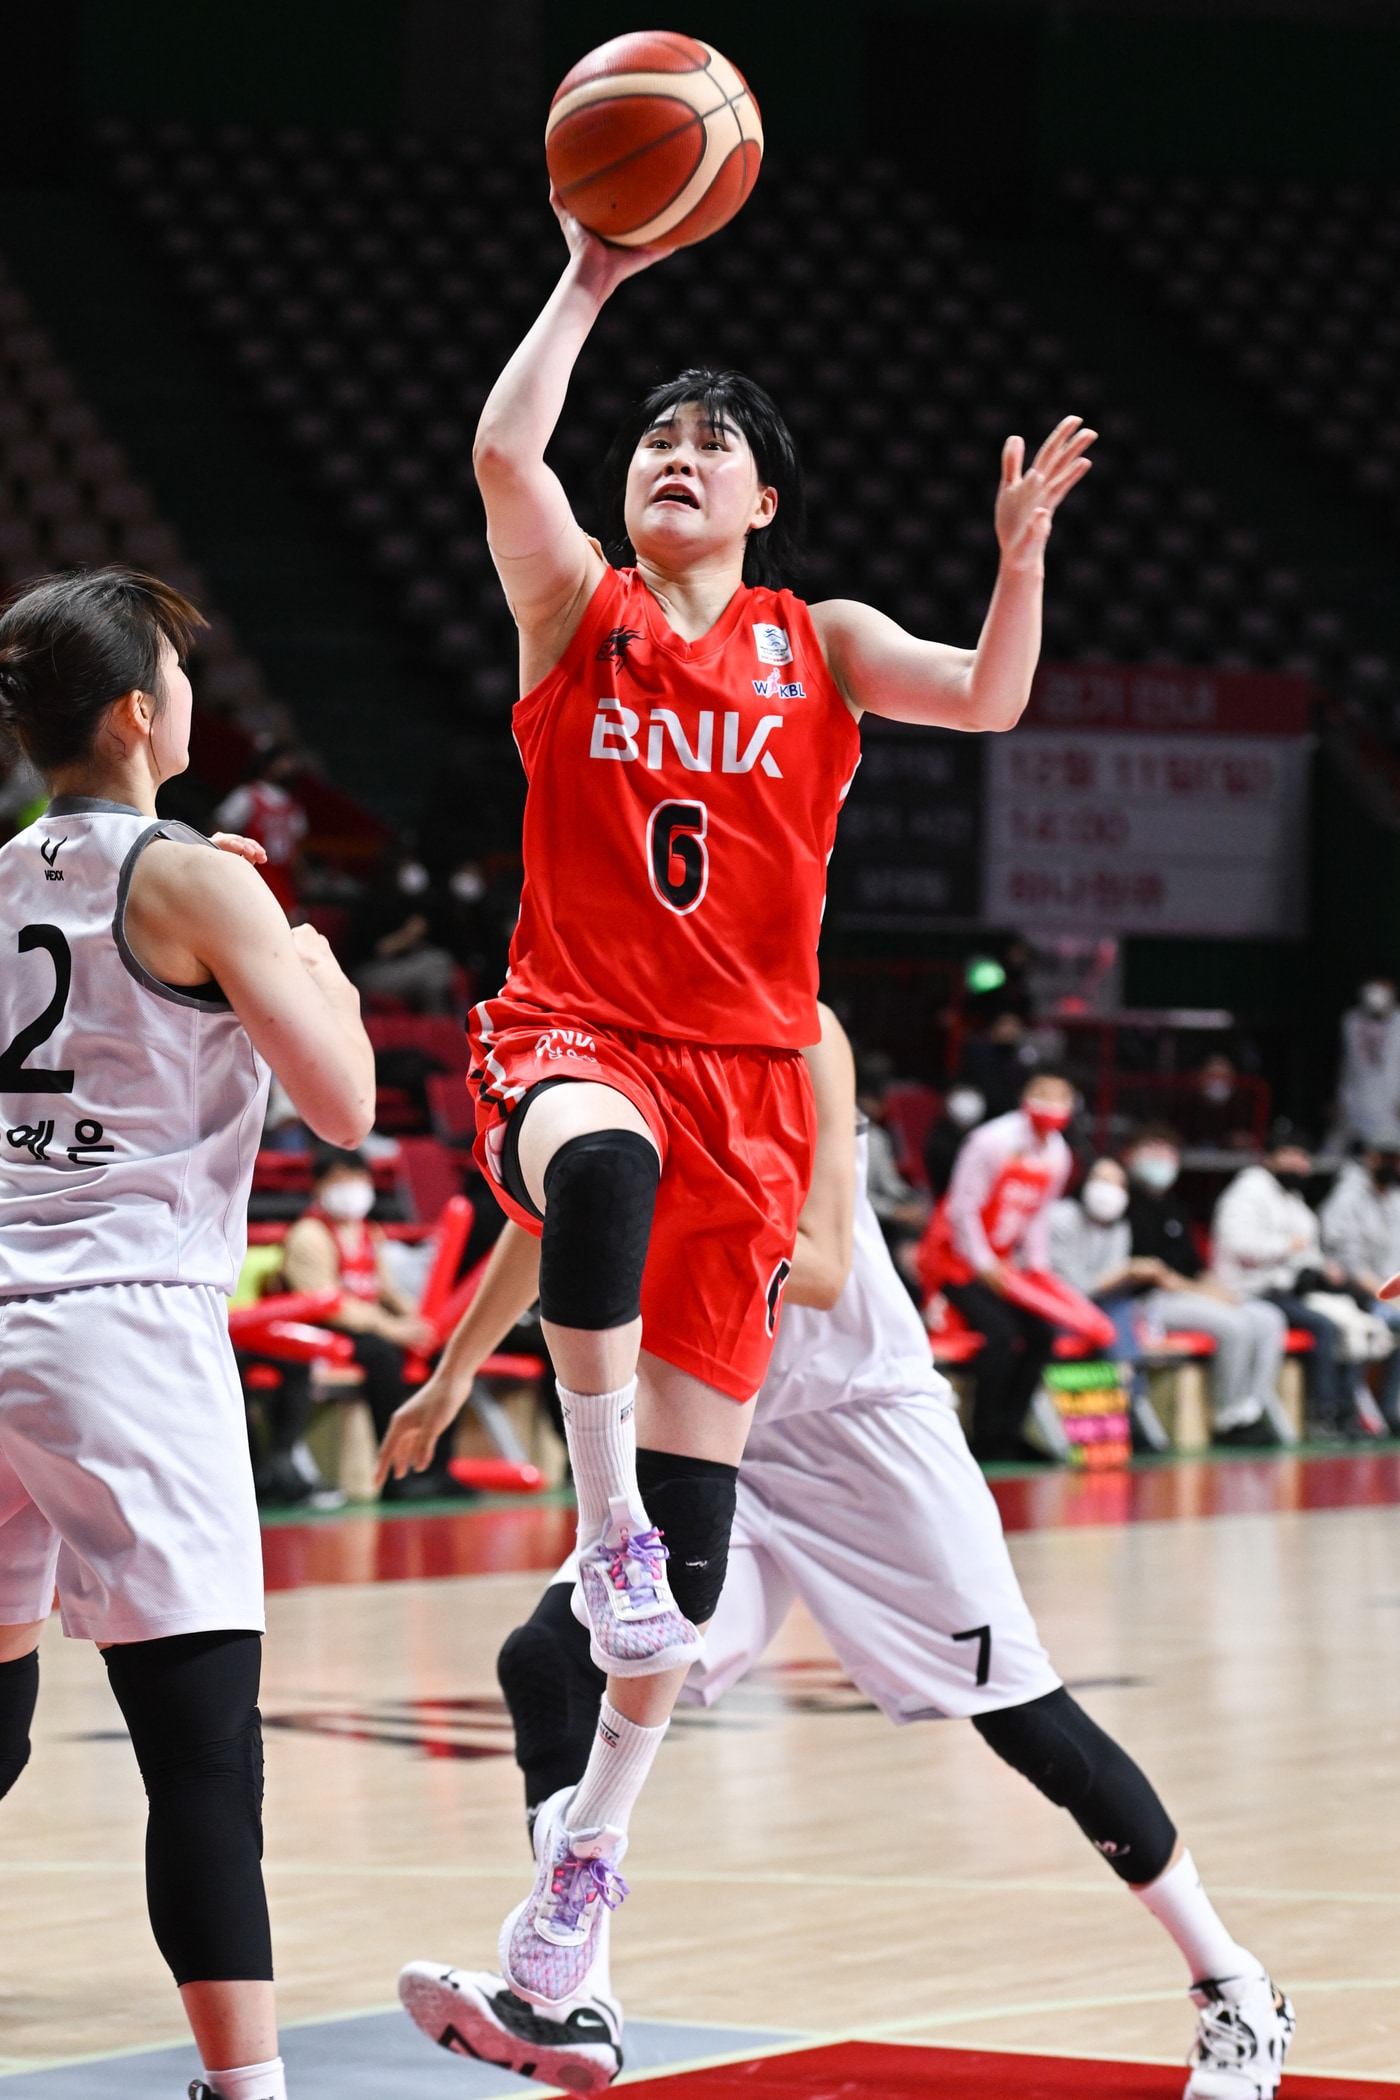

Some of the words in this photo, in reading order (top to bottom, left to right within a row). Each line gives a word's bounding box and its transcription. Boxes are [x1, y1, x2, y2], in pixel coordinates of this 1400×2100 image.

[589, 698, 784, 779] BNK
[44, 869, 65, 881] VEXX
[646, 798, 709, 916] 6
[0, 923, 75, 1094] 2
[0, 1119, 115, 1167] 예은
[951, 1624, 992, 1688] 7
